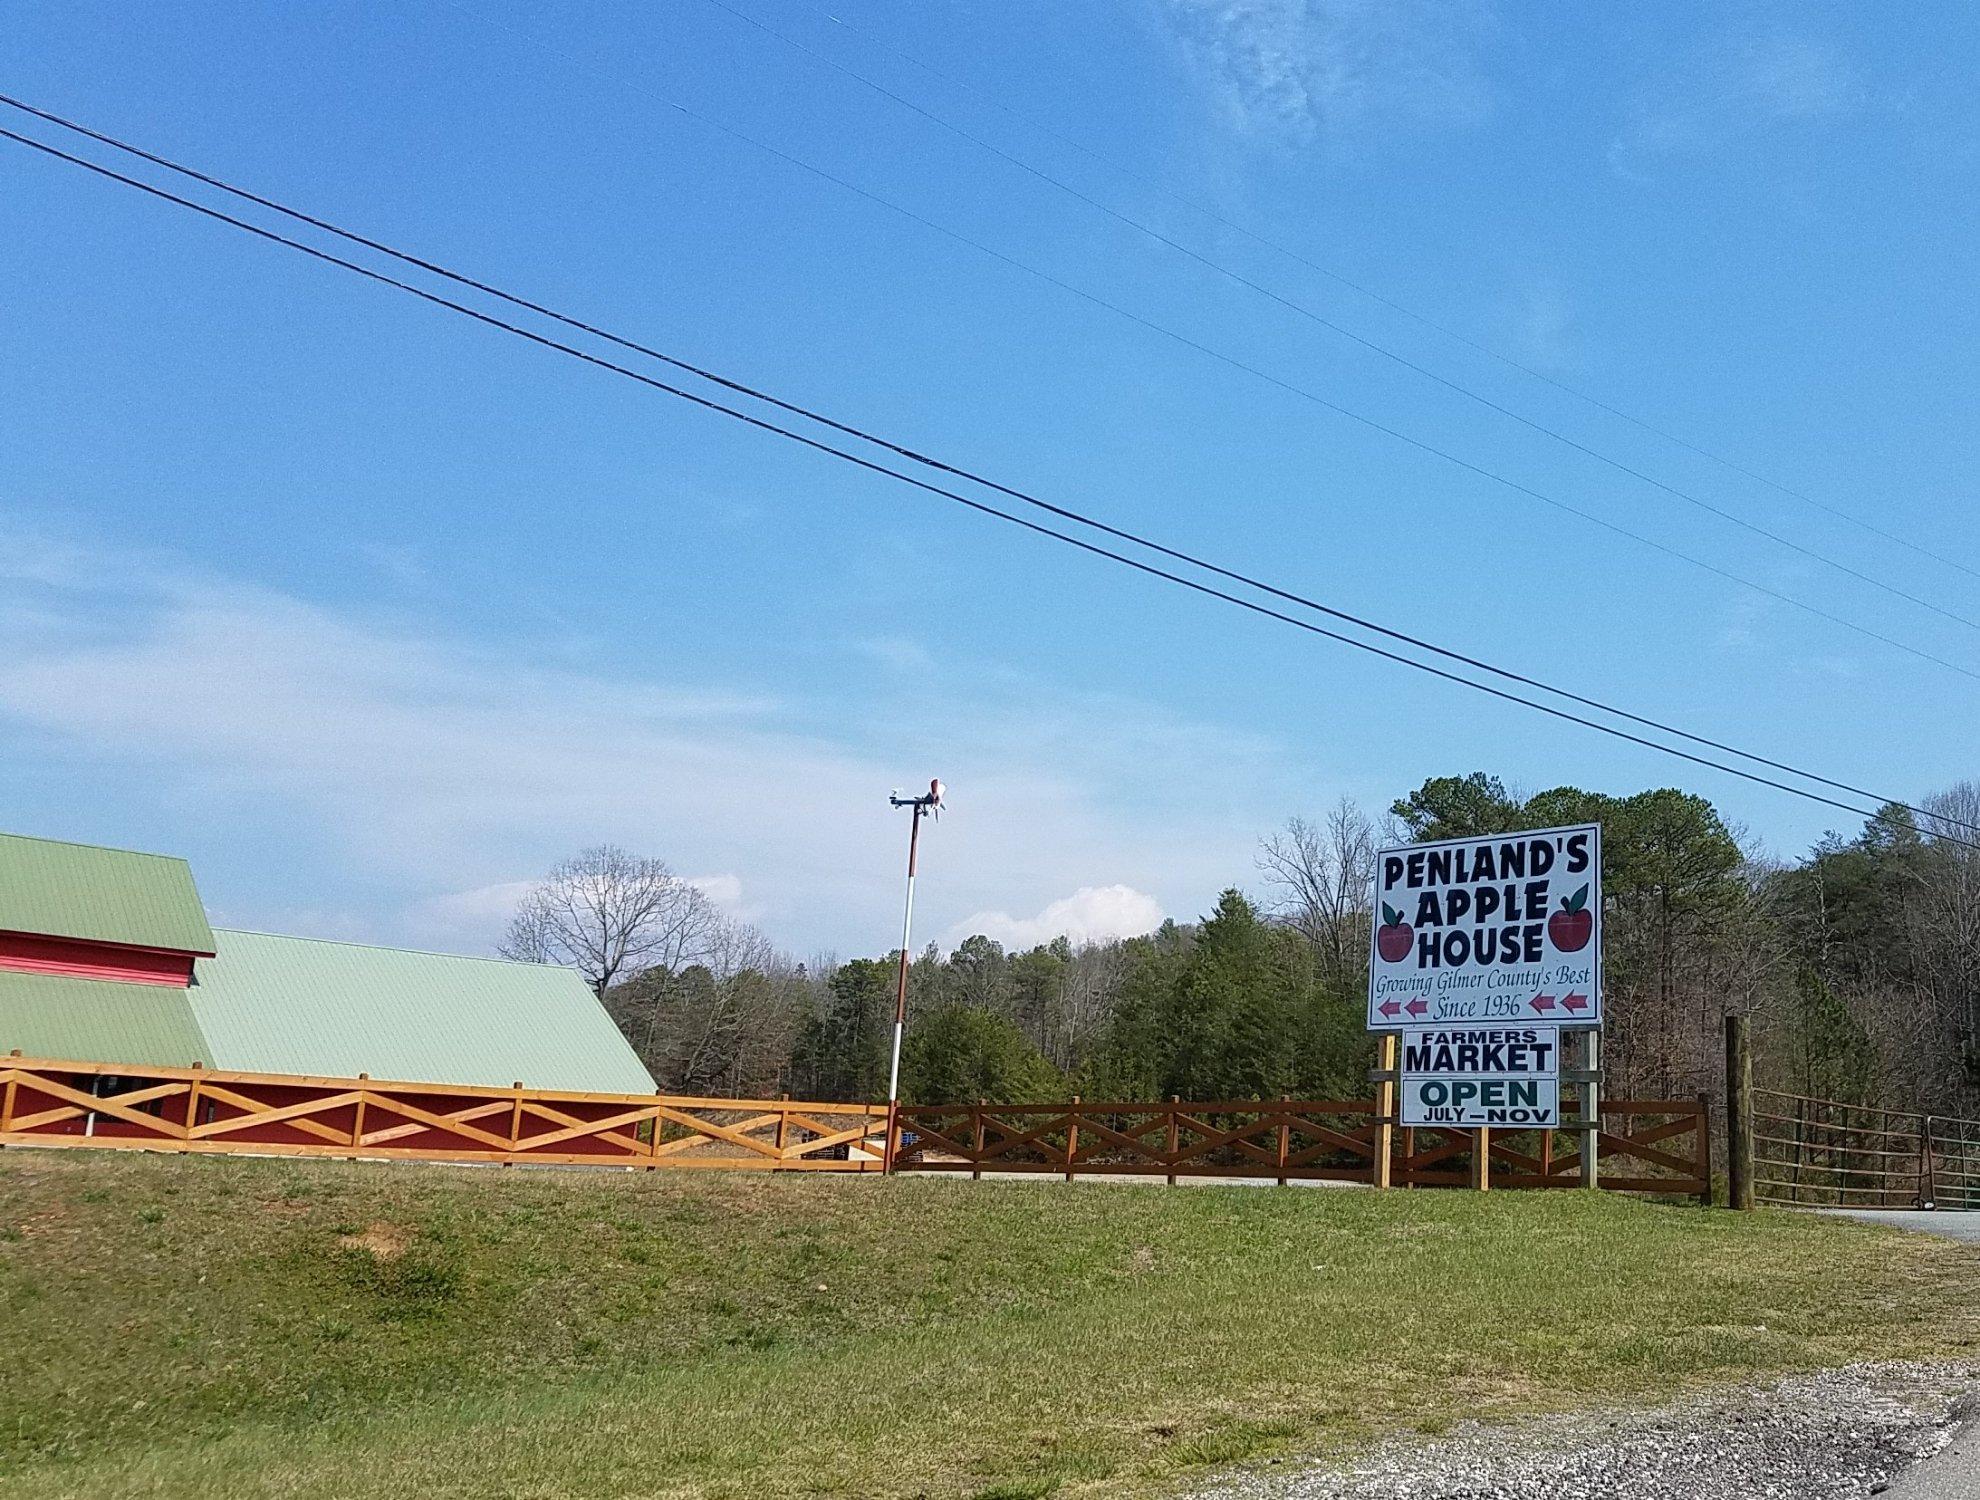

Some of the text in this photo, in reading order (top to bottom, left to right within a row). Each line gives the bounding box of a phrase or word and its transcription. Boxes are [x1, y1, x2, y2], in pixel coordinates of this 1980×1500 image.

[1385, 834, 1589, 890] PENLAND'S
[1414, 880, 1550, 928] APPLE
[1418, 924, 1543, 968] HOUSE
[1377, 965, 1591, 998] Growing Gilmer County's Best
[1433, 994, 1521, 1020] Since 1936
[1422, 1031, 1537, 1044] FARMERS
[1406, 1043, 1552, 1071] MARKET
[1420, 1081, 1539, 1106] OPEN
